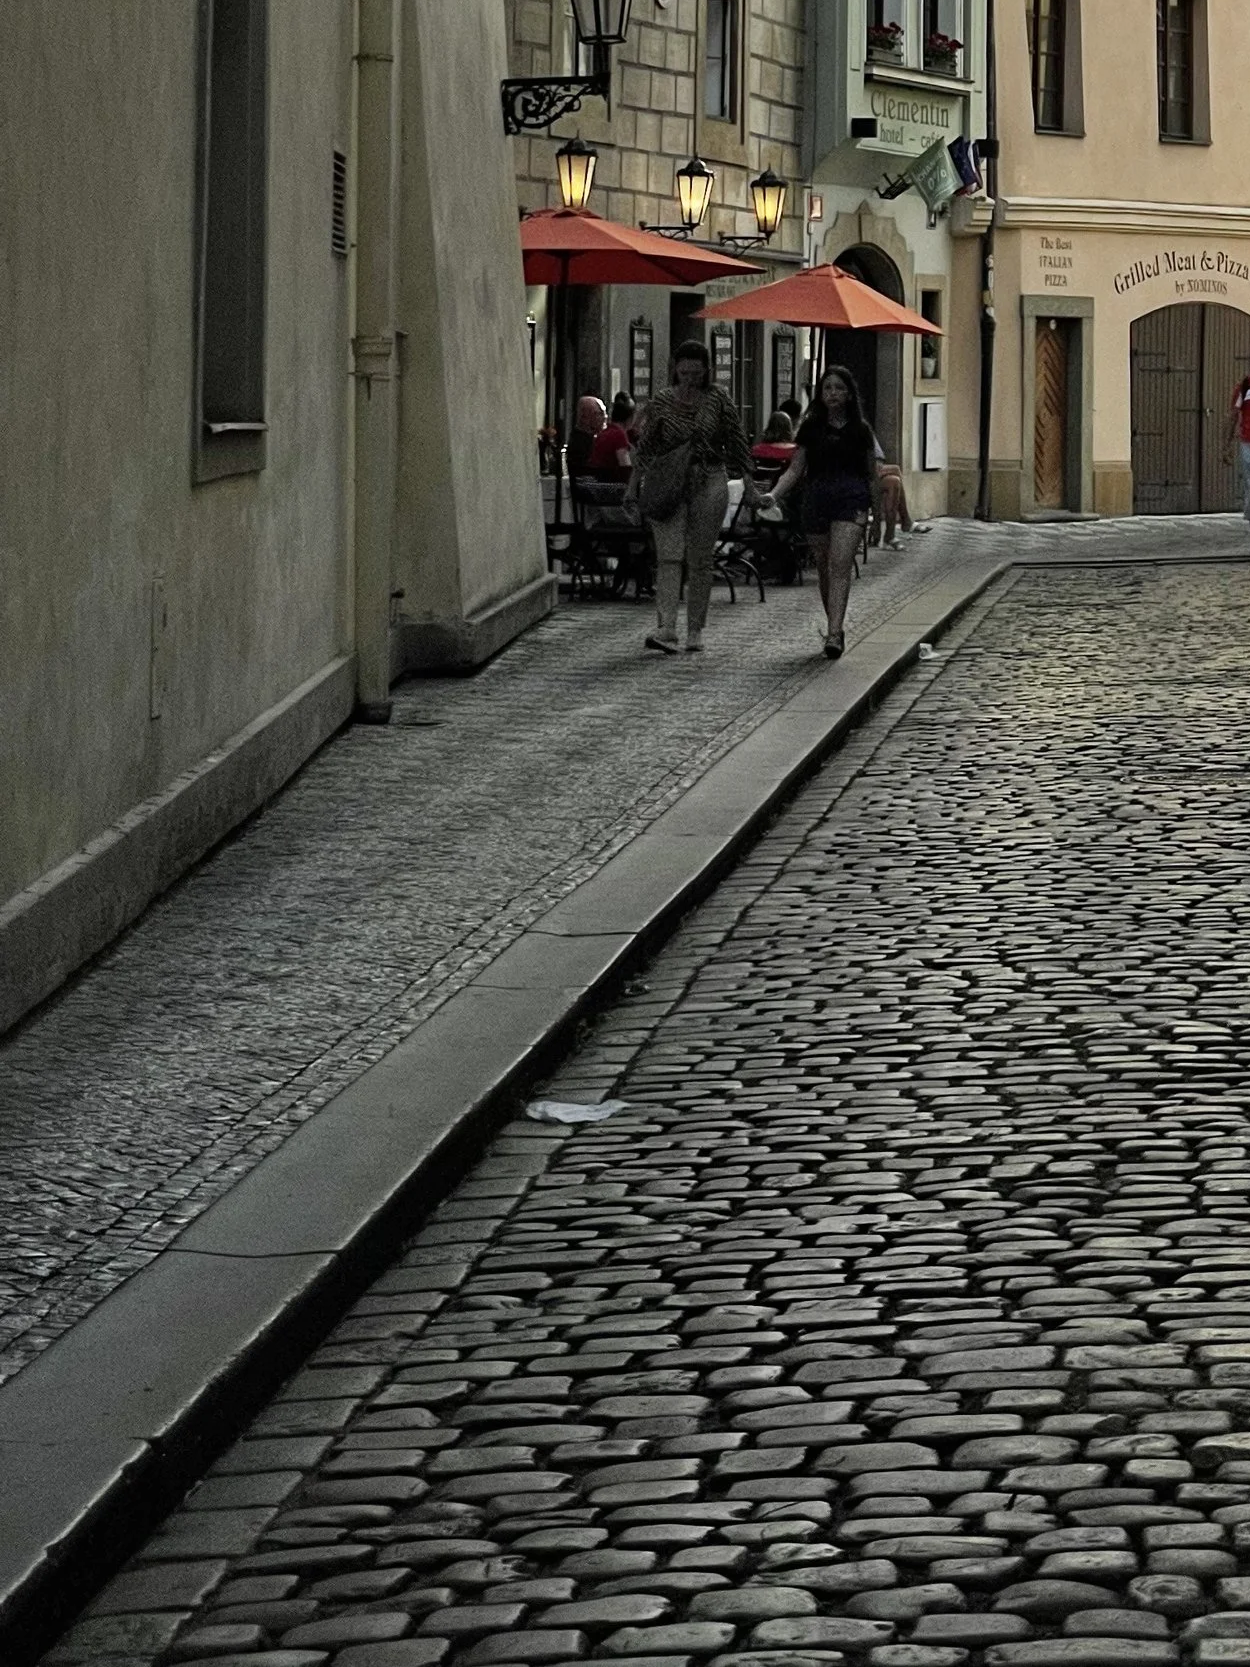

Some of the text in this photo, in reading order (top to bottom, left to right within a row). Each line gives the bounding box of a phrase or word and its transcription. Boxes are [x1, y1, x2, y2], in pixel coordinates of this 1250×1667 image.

[870, 91, 949, 128] Clementin
[880, 123, 904, 145] hotel
[1040, 236, 1072, 250] The Best
[1039, 255, 1073, 268] ITALIAN
[1044, 274, 1067, 286] PIZZA
[1114, 255, 1160, 295] Grilled
[1164, 251, 1196, 274] Meat
[1200, 250, 1215, 272] &
[1217, 251, 1249, 280] Pizza
[1175, 279, 1228, 296] by NOMINOS
